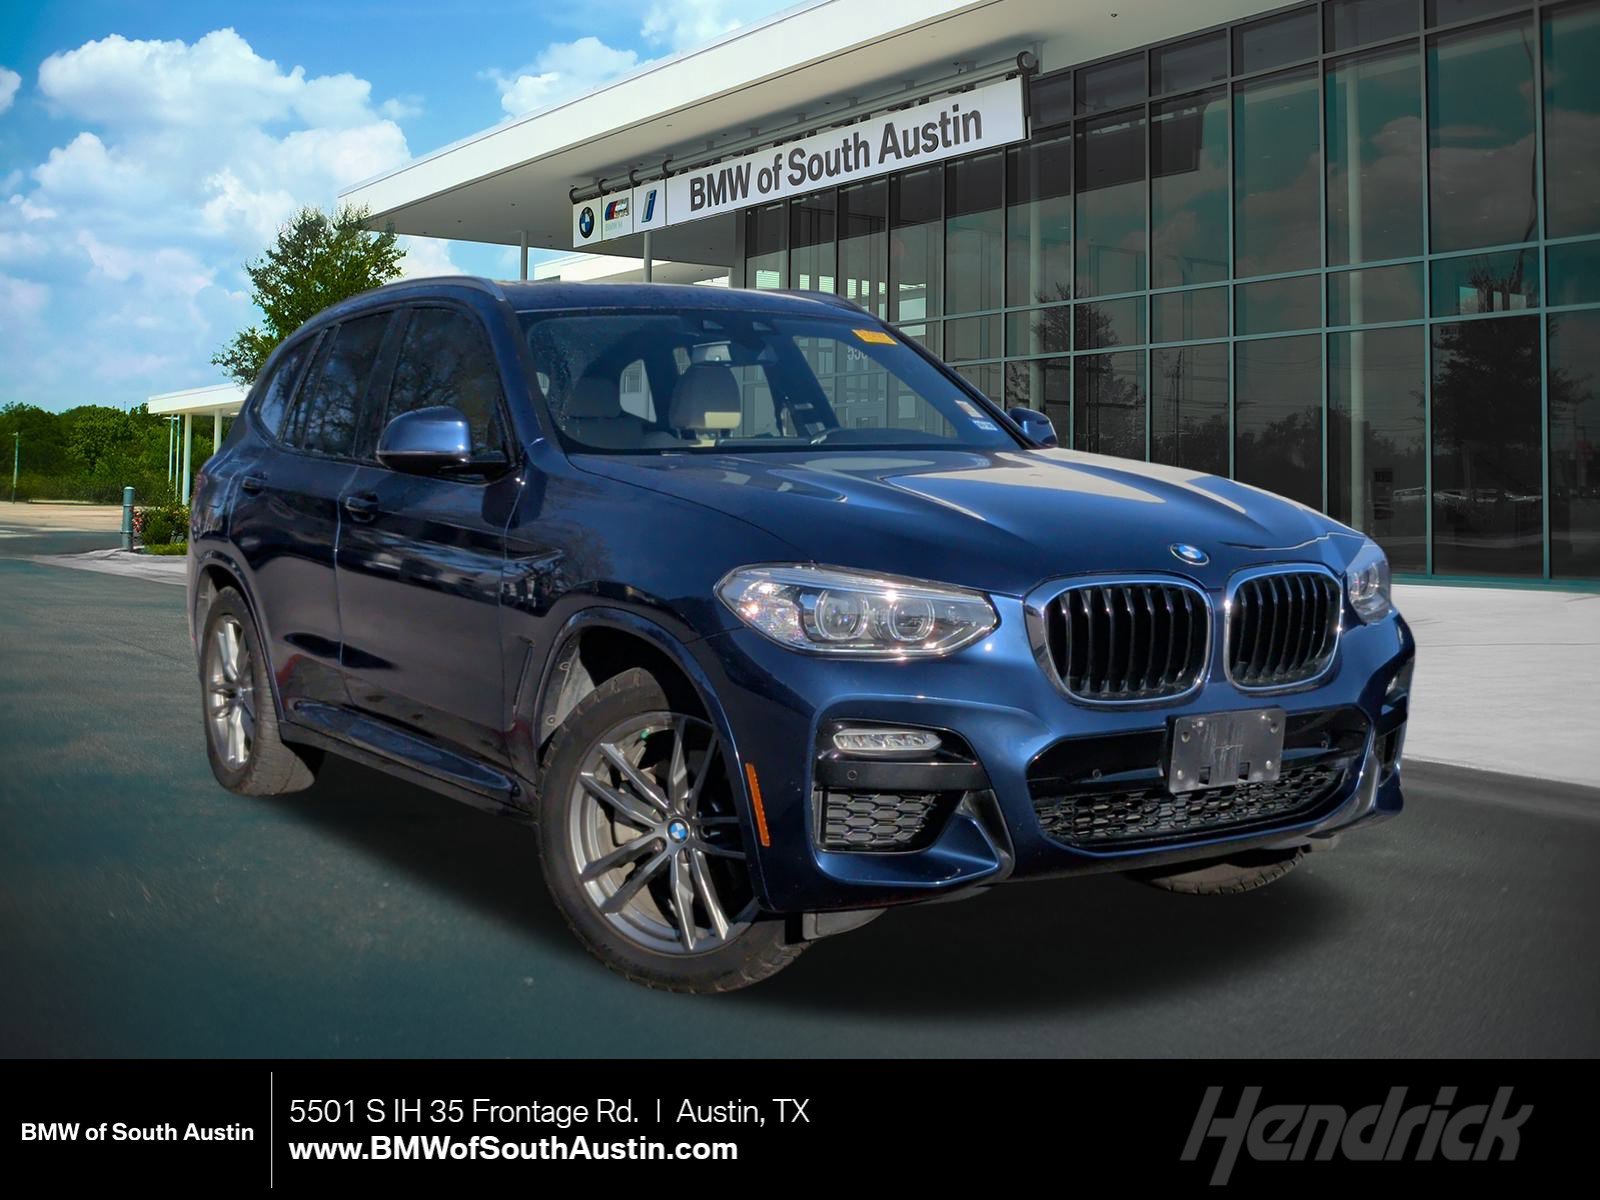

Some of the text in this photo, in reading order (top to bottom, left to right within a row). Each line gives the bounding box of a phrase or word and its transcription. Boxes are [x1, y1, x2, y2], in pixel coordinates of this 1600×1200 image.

[689, 104, 983, 212] BMW of South Austin
